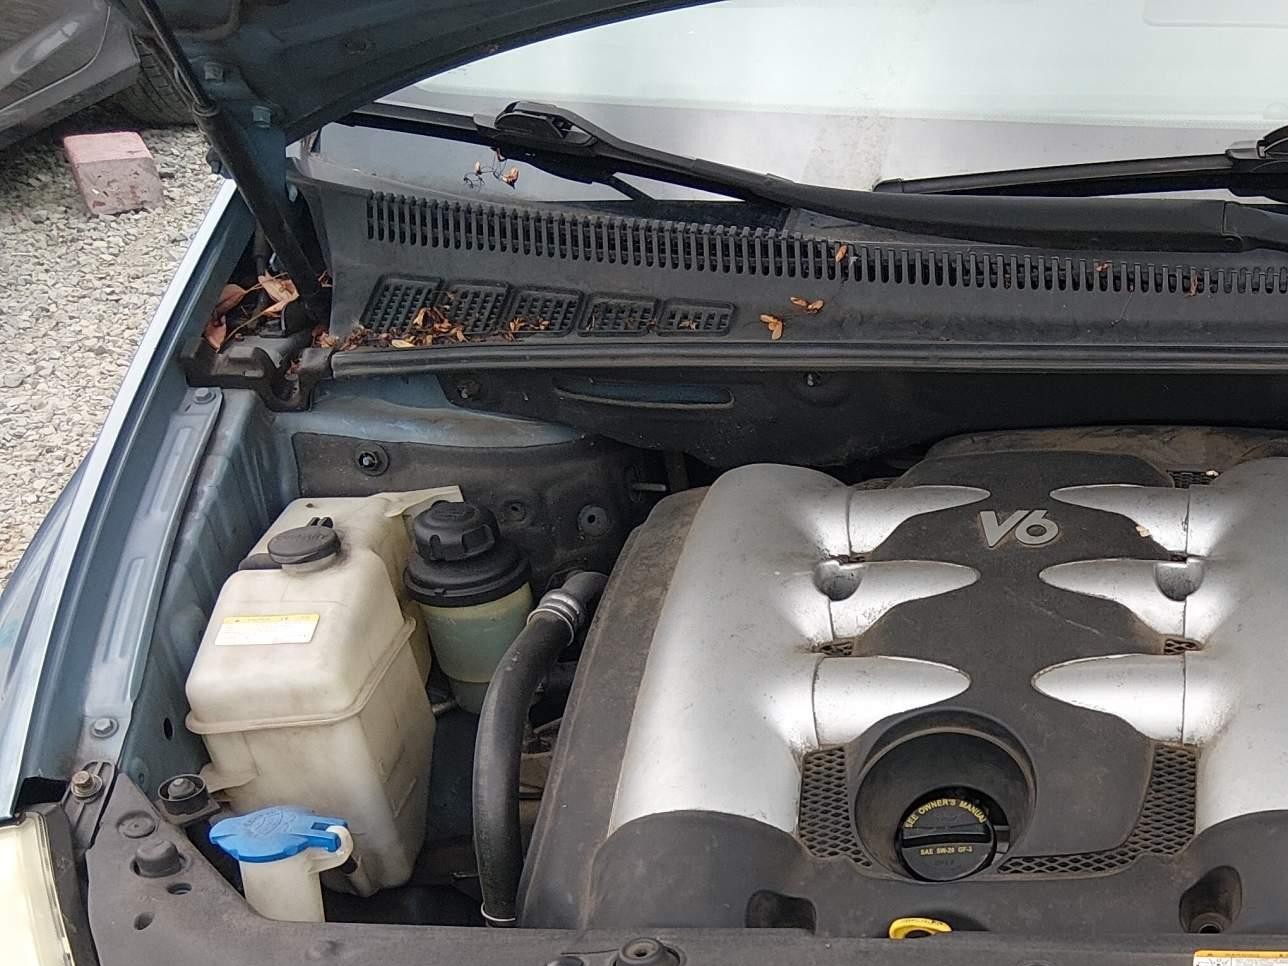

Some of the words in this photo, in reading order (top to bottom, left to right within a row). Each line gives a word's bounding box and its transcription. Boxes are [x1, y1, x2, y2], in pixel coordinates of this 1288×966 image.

[980, 509, 1059, 548] V6
[904, 816, 919, 828] SEE
[919, 799, 956, 815] OWNER'S
[959, 801, 987, 823] MANUAL
